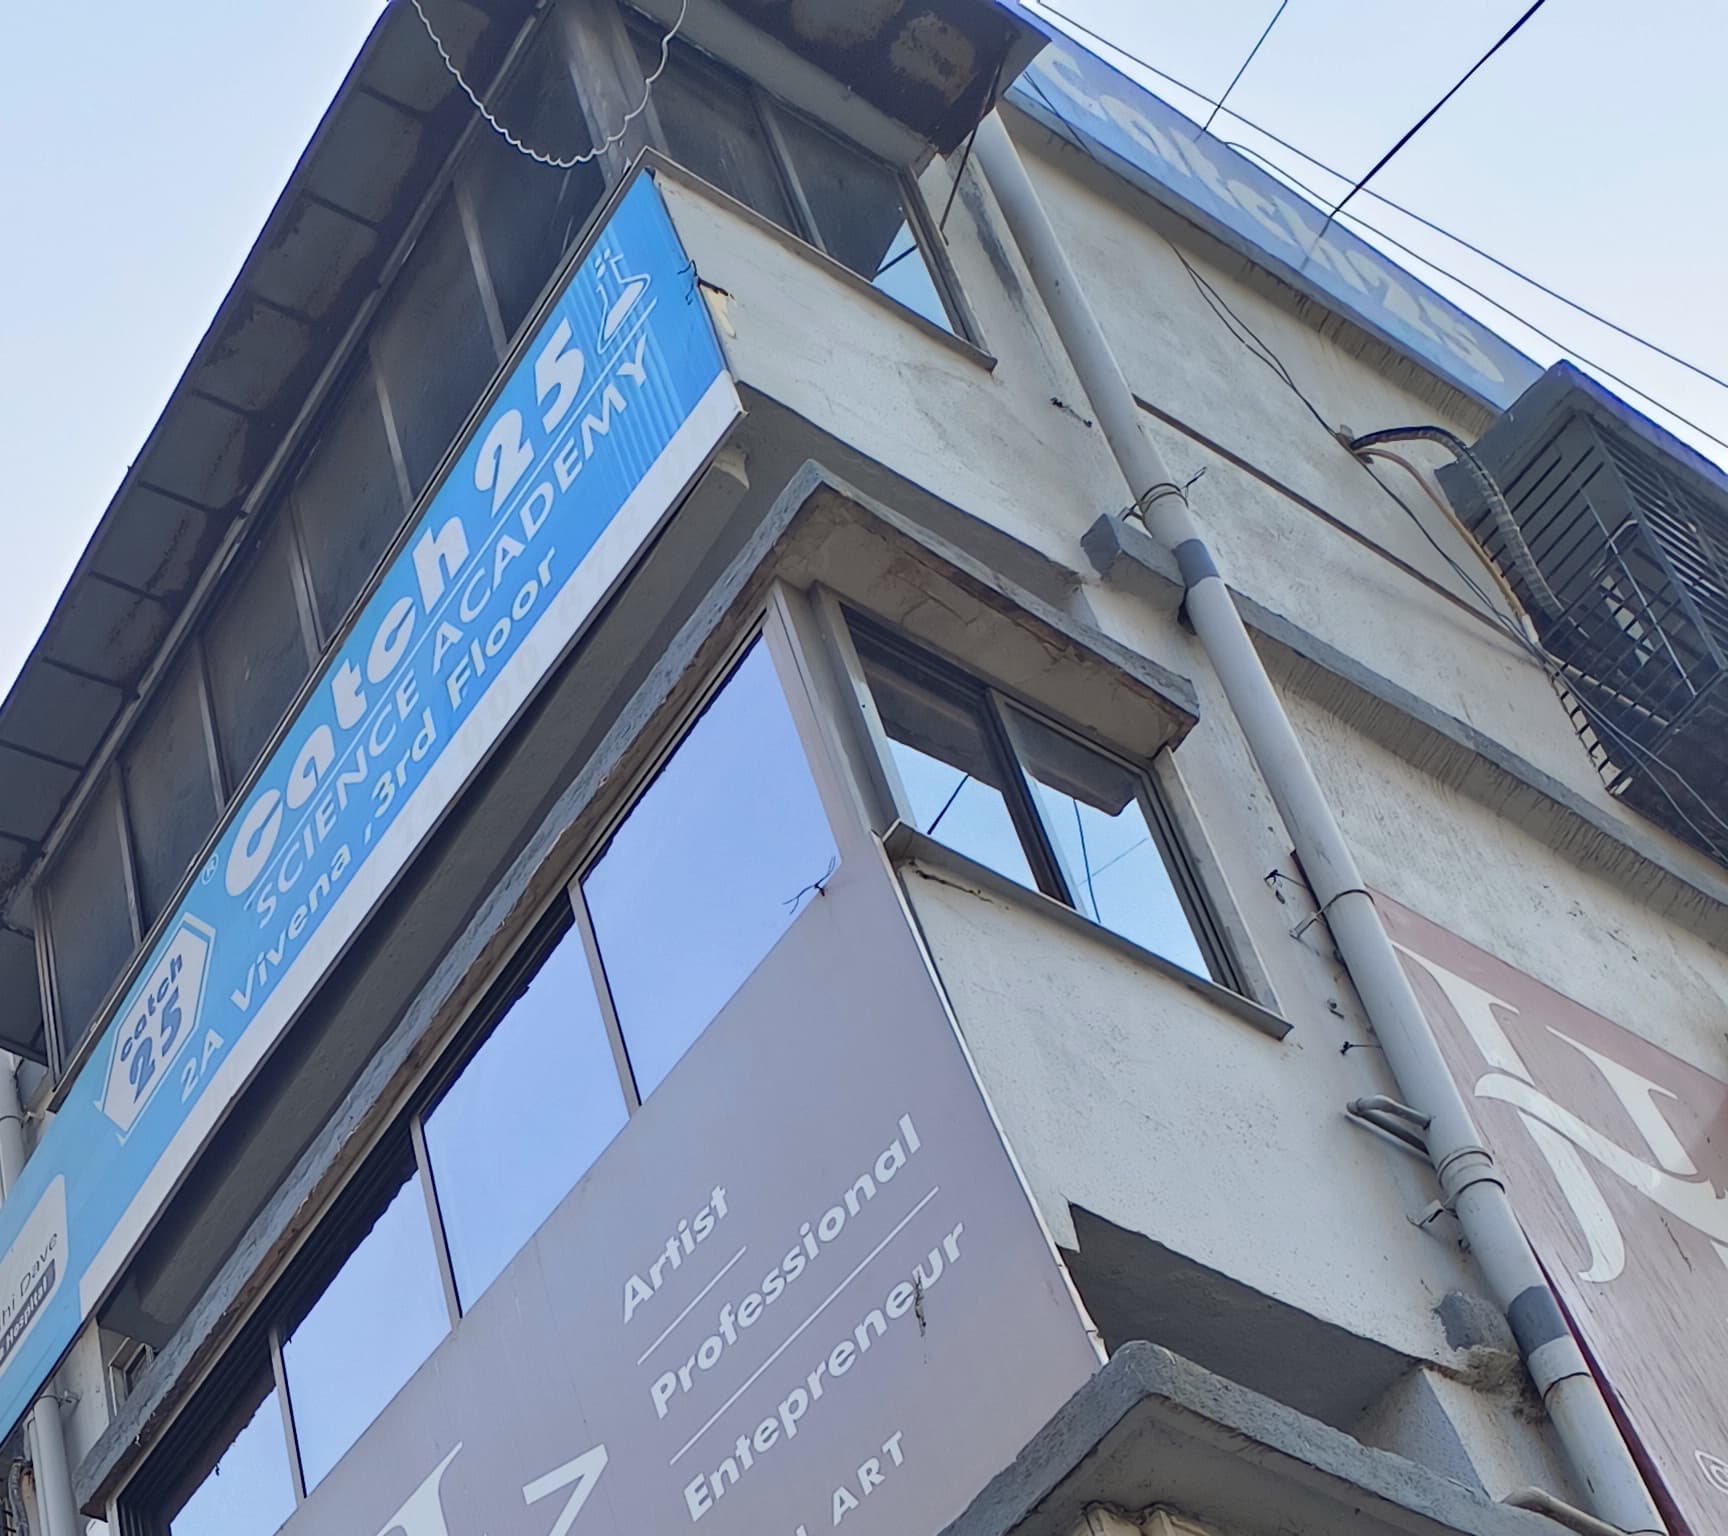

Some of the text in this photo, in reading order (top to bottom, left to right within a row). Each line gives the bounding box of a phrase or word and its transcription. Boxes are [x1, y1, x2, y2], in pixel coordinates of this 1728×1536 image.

[225, 317, 585, 896] Catch 25
[255, 334, 648, 928] SCIENCE ACADEMY
[180, 1027, 223, 1103] 2A
[230, 844, 351, 1016] Vivena
[446, 547, 556, 711] Floor
[129, 997, 183, 1104] 25
[5, 1275, 49, 1352] Hospital
[623, 1185, 728, 1324] Artist
[650, 1113, 921, 1420] Professional
[683, 1222, 965, 1522] Entepreneur
[833, 1430, 905, 1526] ART
